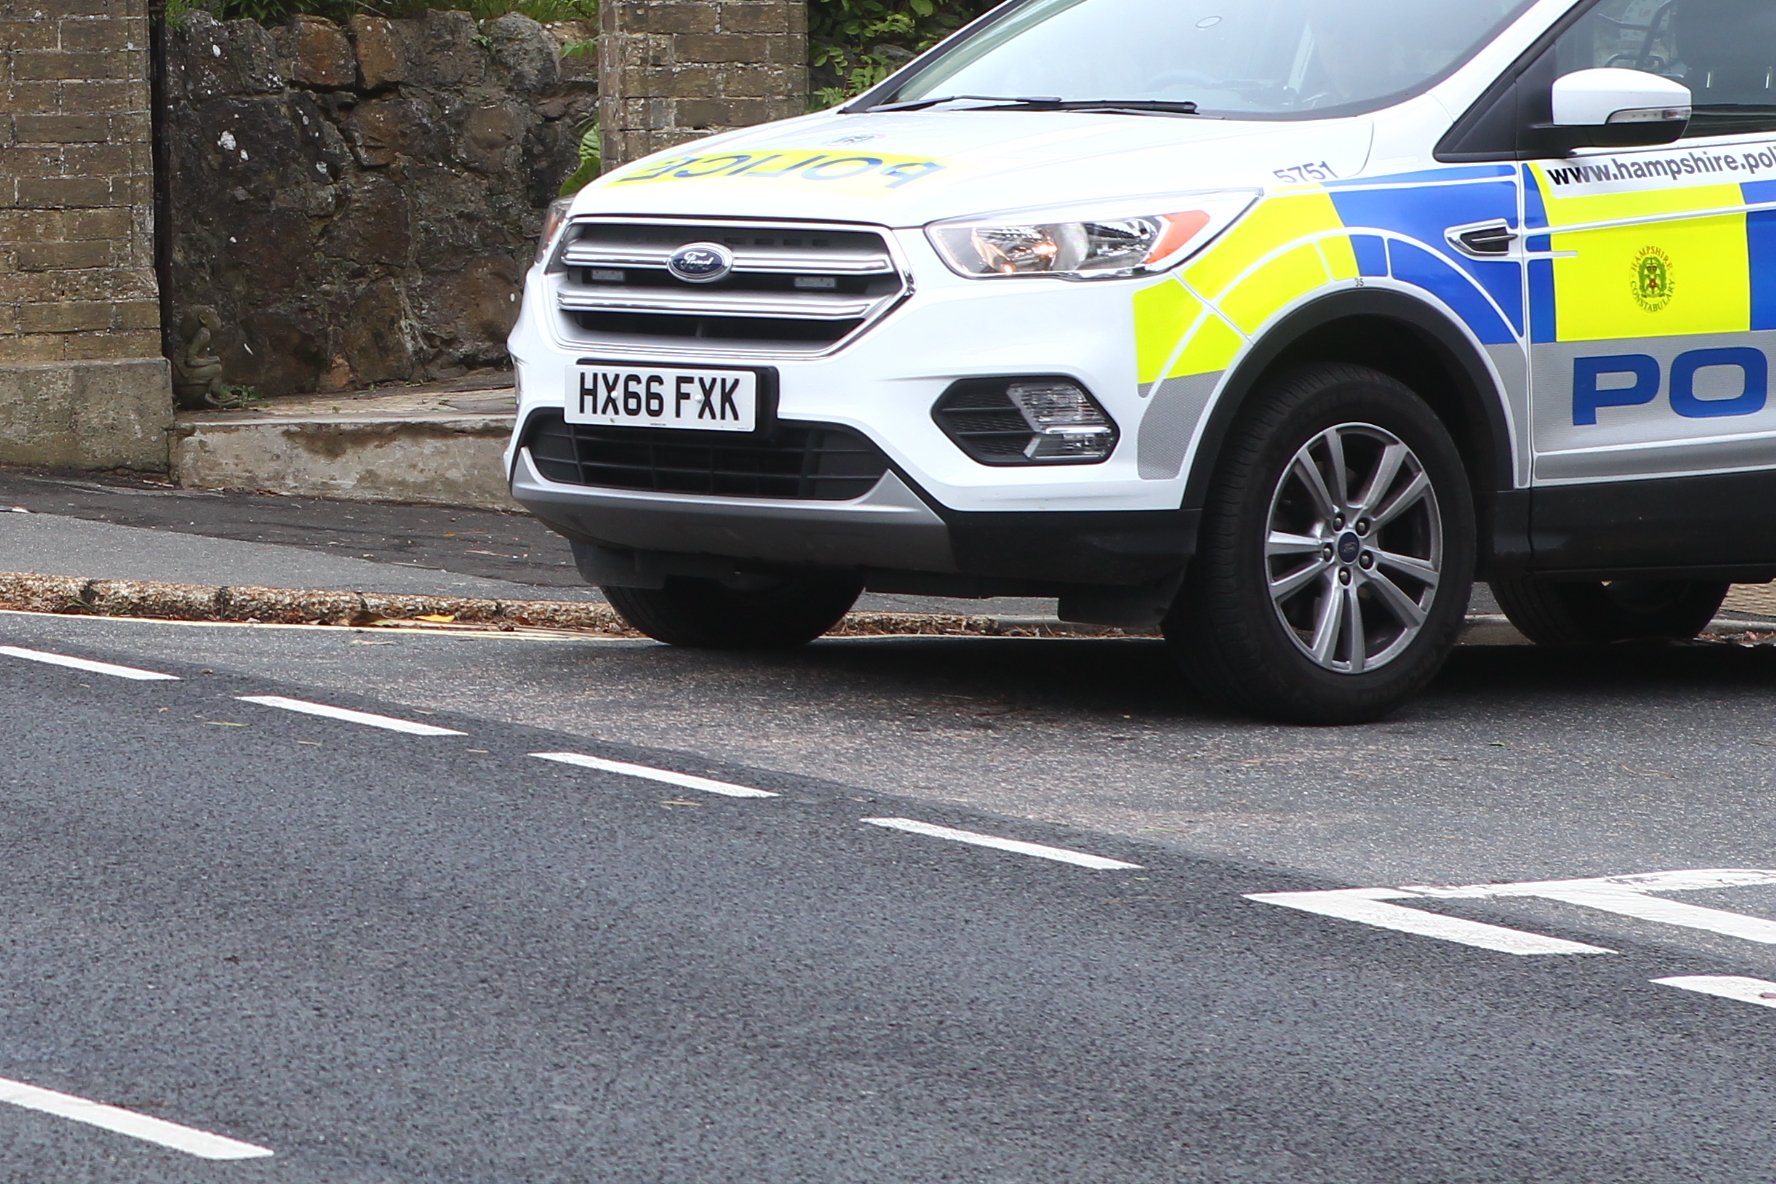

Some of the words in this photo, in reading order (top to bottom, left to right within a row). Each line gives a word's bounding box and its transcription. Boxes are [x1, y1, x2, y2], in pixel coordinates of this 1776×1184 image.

[1272, 160, 1340, 184] 5751
[1630, 245, 1674, 272] HAMPSHIRE
[1354, 277, 1365, 288] 35
[1630, 278, 1676, 313] CONSTABULARY
[579, 371, 664, 418] HX66
[674, 375, 741, 421] FXK
